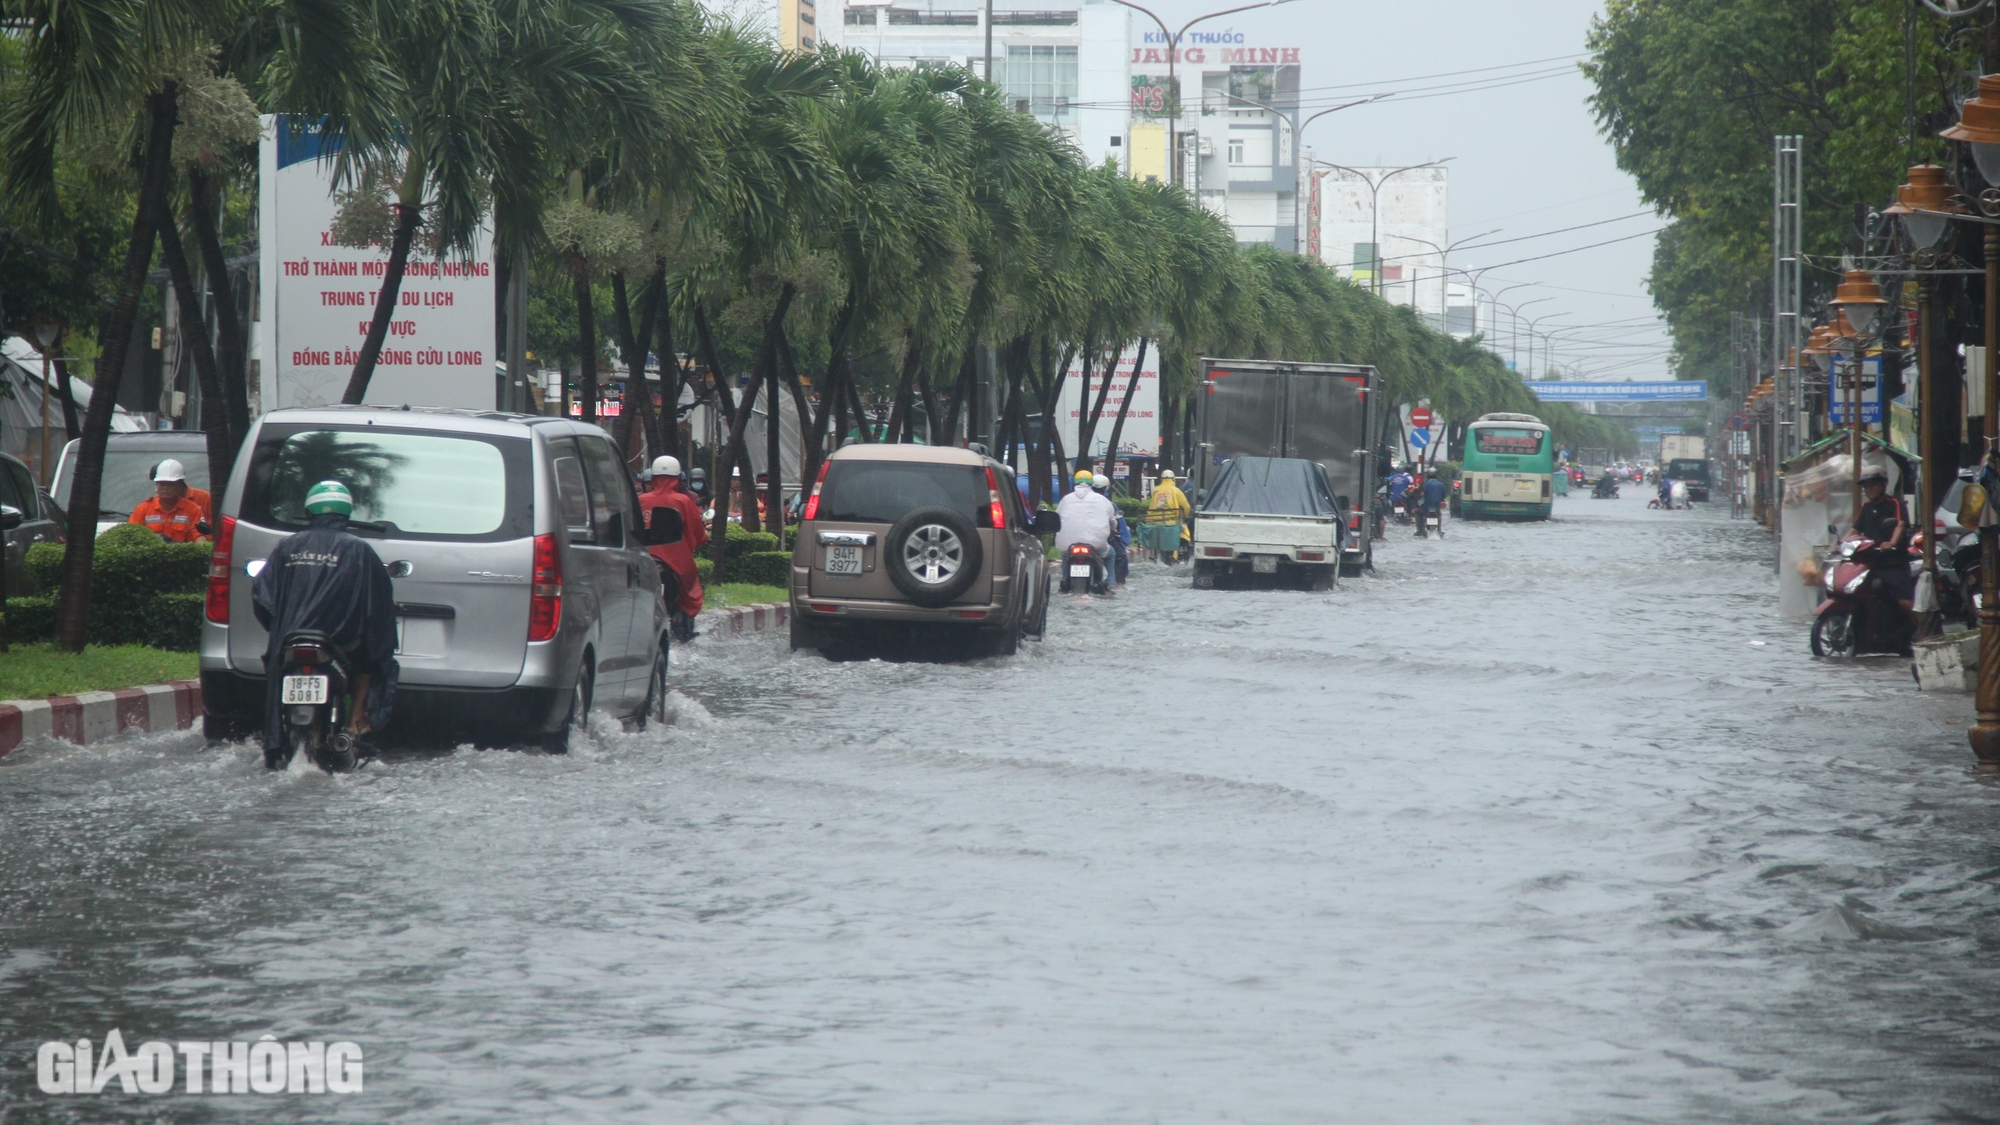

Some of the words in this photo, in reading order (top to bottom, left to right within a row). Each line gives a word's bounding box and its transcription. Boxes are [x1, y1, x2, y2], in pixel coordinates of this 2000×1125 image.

[1221, 47, 1300, 63] MINH
[283, 257, 309, 276] TRỞ
[313, 259, 357, 276] THÀNH
[401, 261, 438, 277] RONG
[321, 291, 365, 306] TRUNG
[402, 291, 419, 306] DU
[424, 291, 453, 309] LỊCH
[292, 346, 330, 366] ĐỒNG
[334, 345, 362, 366] BẰN
[447, 351, 482, 366] LONG
[833, 547, 856, 559] 94H
[829, 560, 858, 572] 3977
[289, 690, 321, 702] 5081
